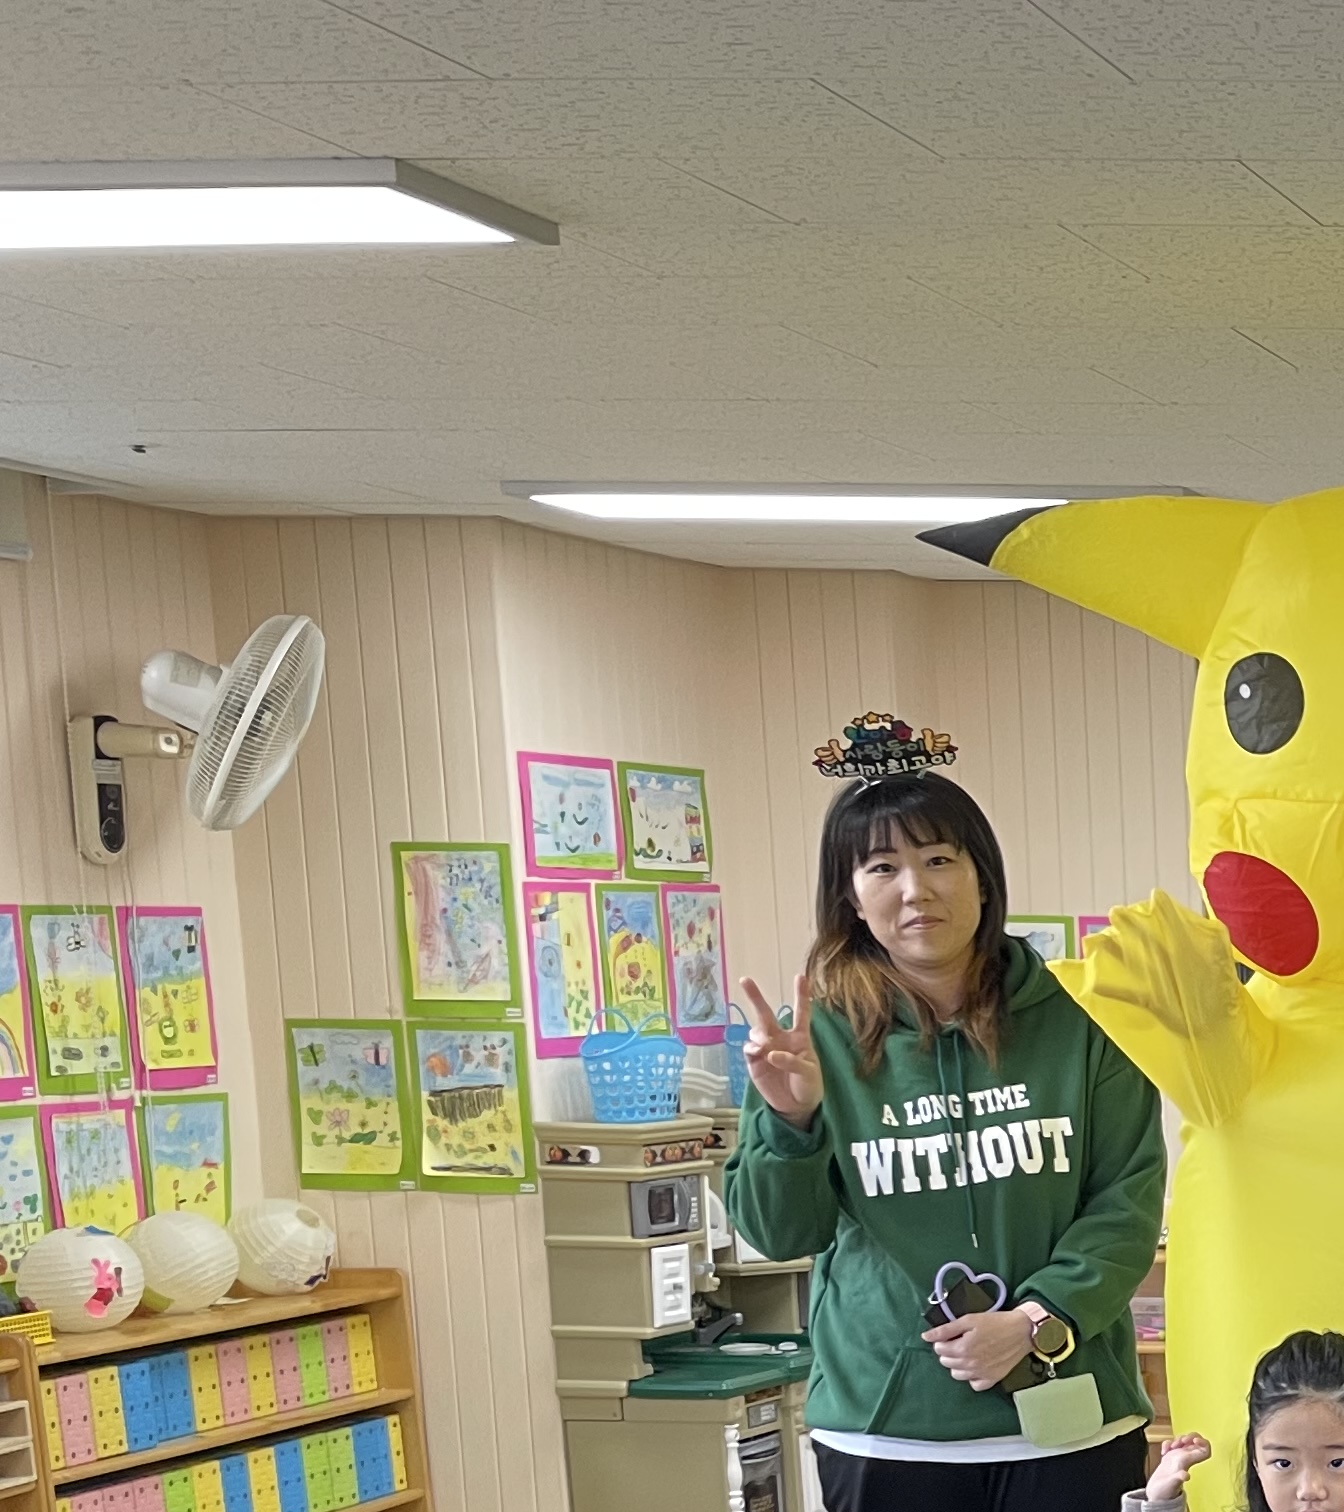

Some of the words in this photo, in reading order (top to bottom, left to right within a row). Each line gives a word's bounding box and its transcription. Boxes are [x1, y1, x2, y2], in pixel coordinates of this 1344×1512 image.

[845, 738, 925, 761] 사랑둥이
[881, 1103, 900, 1127] A
[903, 1093, 964, 1126] LONG
[966, 1083, 1031, 1116] TIME
[851, 1116, 1074, 1198] WITHOUT
